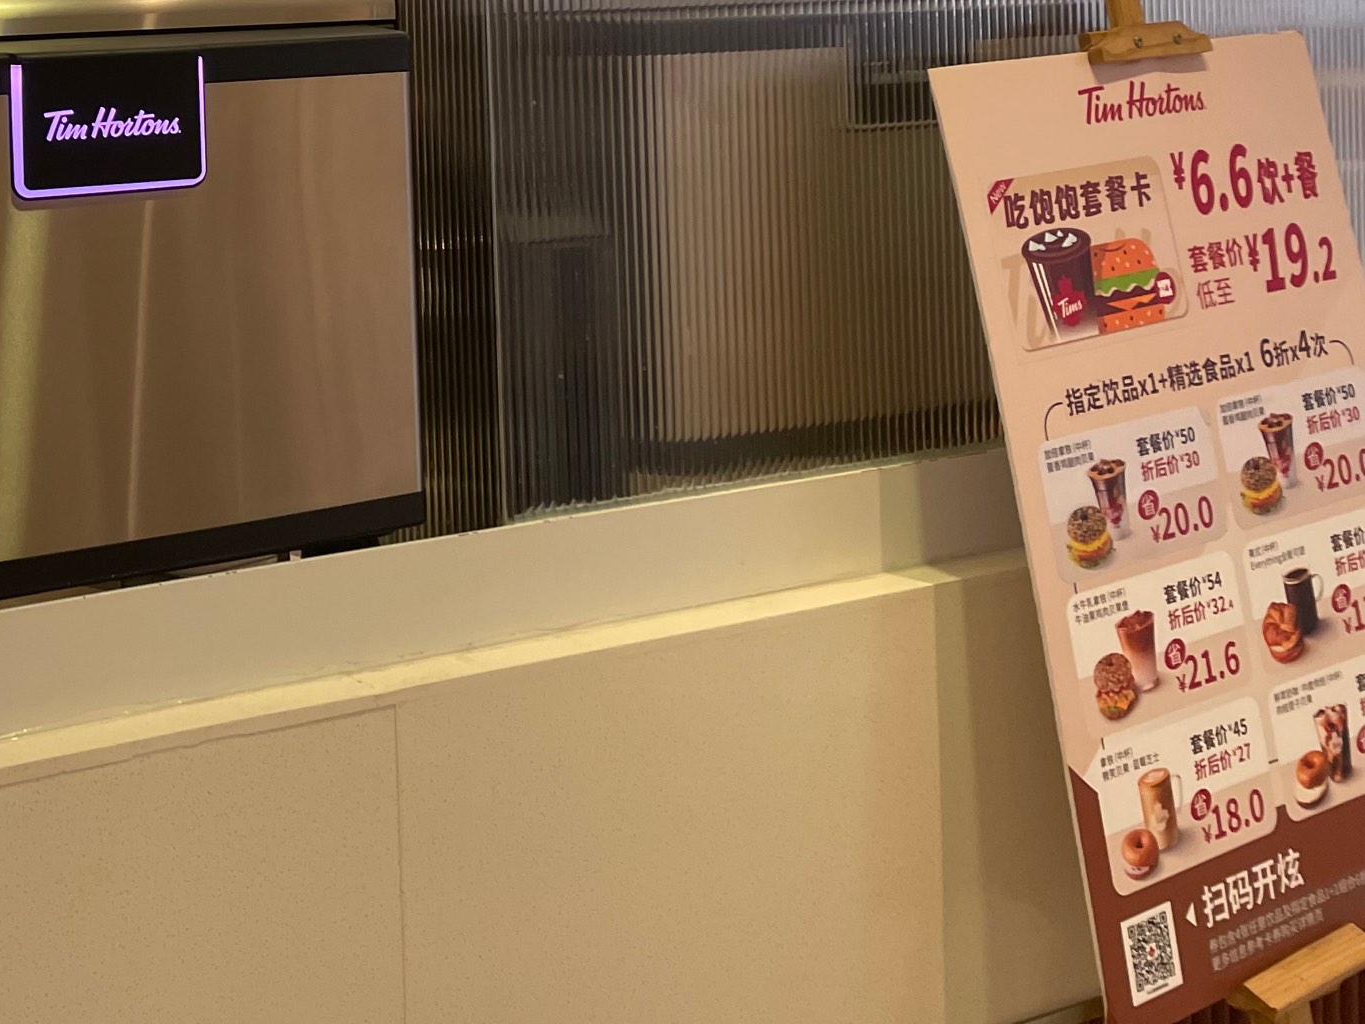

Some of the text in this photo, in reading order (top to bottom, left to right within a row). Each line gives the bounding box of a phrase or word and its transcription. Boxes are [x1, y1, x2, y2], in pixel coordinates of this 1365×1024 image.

[43, 106, 182, 142] Tim Hortons
[1077, 80, 1207, 126] Tim Hortons
[1003, 172, 1152, 229] 吃饱饱套餐卡
[1057, 297, 1083, 319] Tims
[1196, 279, 1236, 310] 低至
[1150, 495, 1214, 543] ¥20.0
[1176, 641, 1240, 693] ¥21.6
[1202, 788, 1265, 843] ¥18.0
[1201, 848, 1305, 928] 扫码开炫
